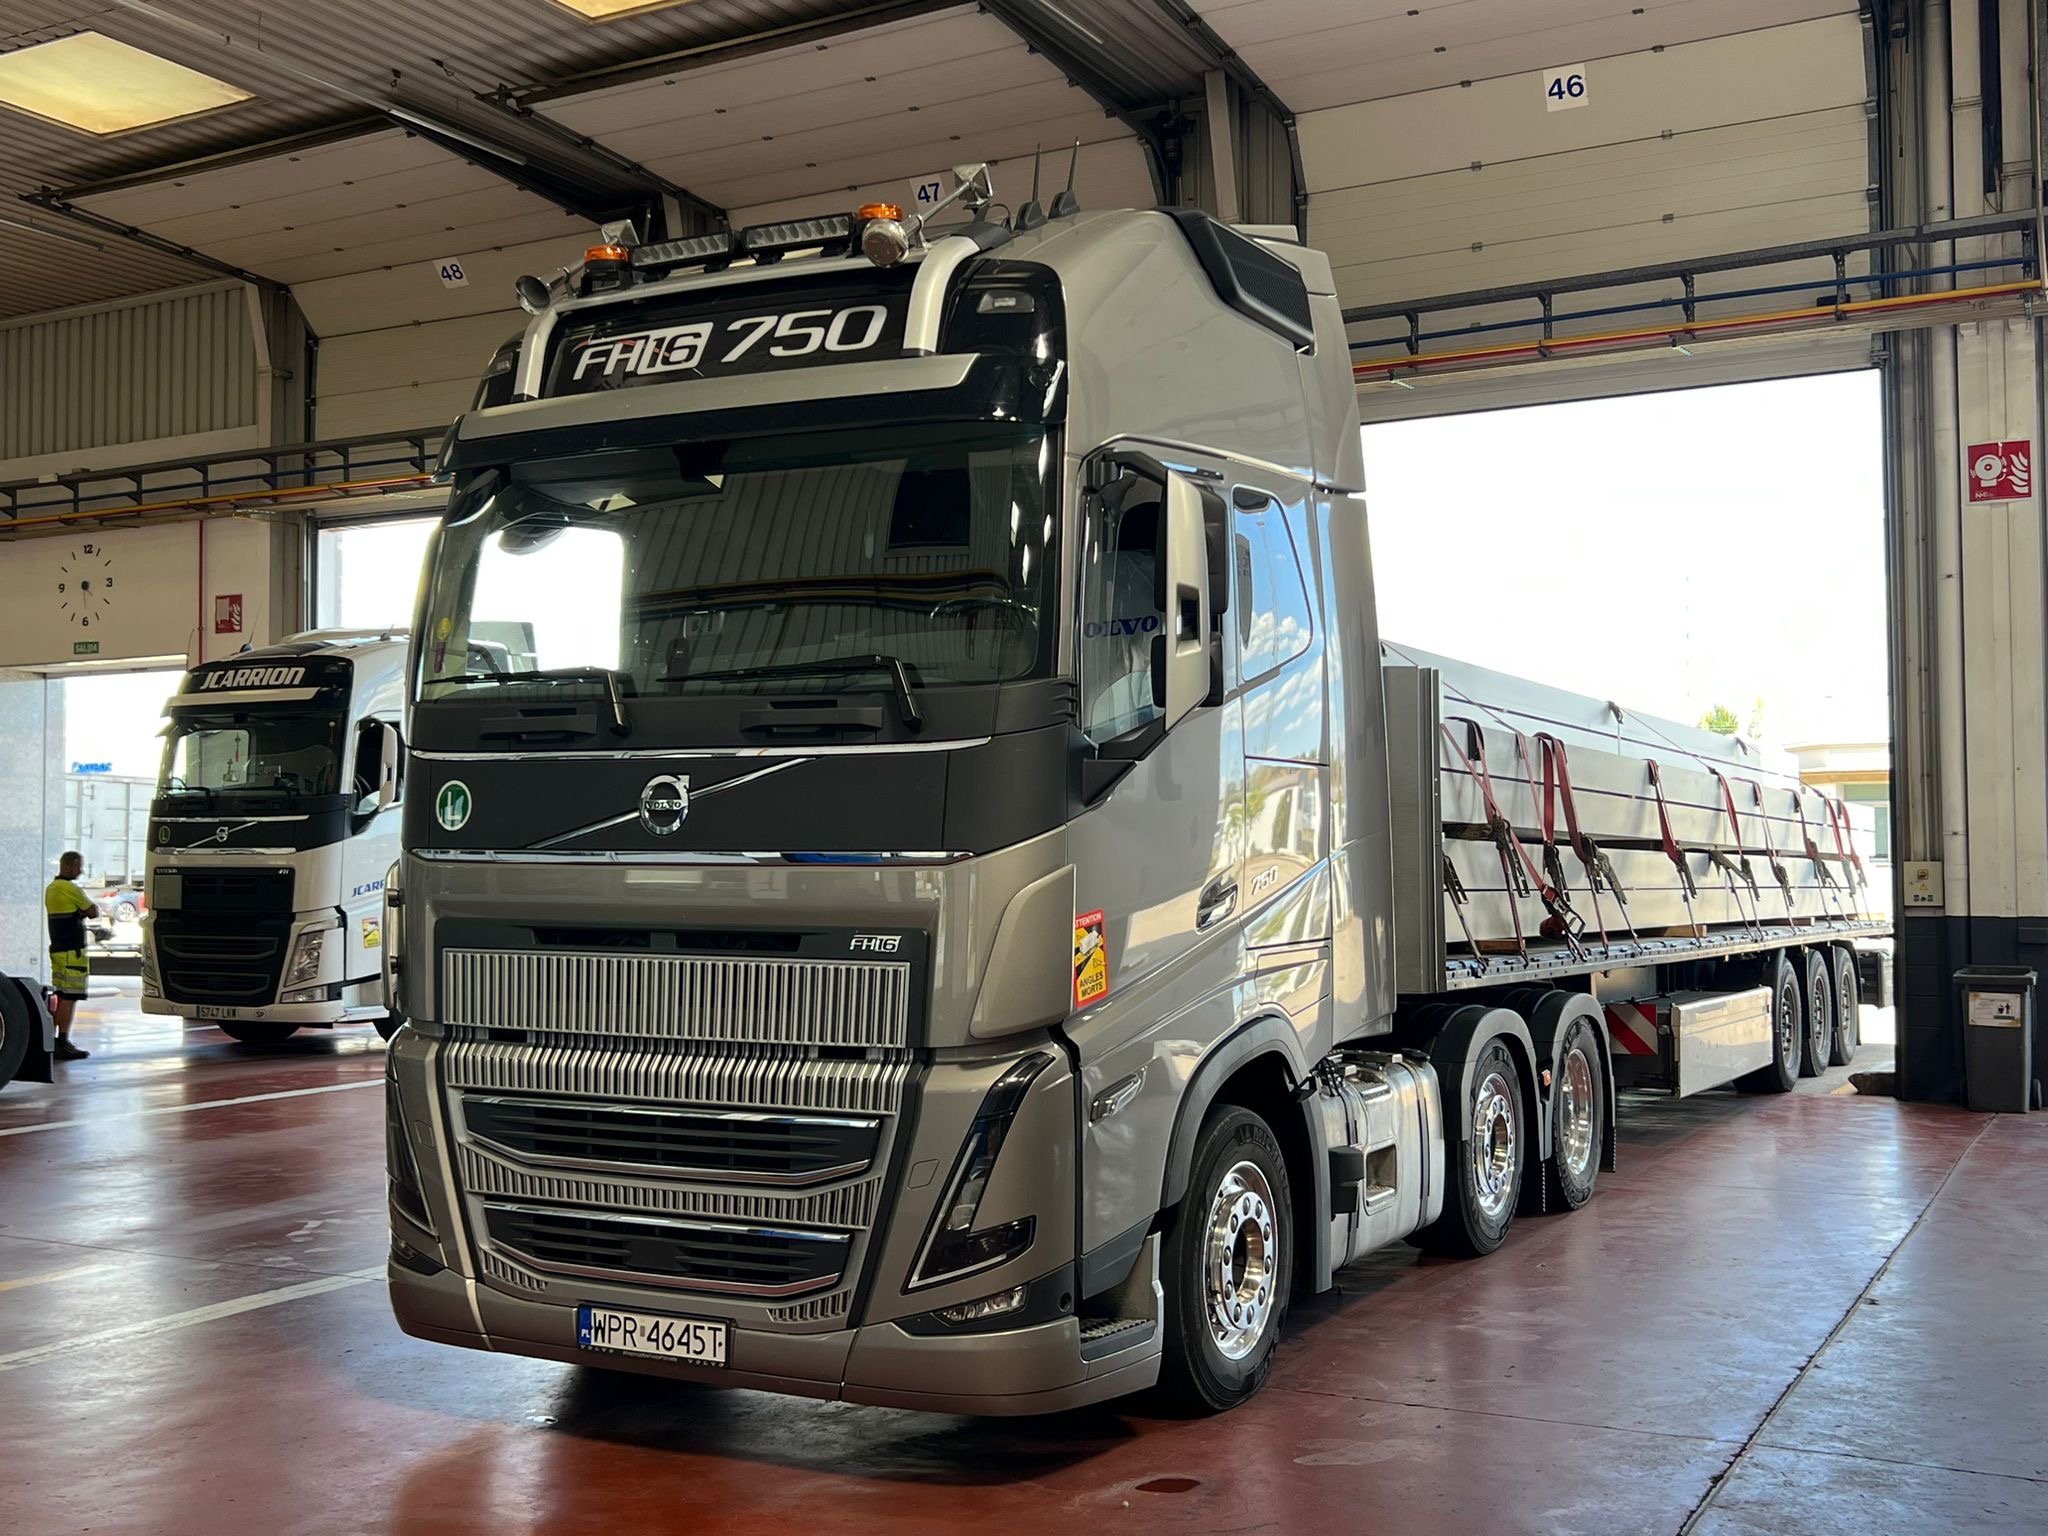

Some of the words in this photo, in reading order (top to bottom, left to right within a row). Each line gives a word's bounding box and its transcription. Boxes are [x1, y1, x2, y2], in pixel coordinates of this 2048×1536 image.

[1548, 74, 1585, 100] 46
[917, 182, 940, 203] 47
[441, 263, 464, 281] 48
[573, 322, 714, 381] FH16
[721, 305, 888, 363] 750
[83, 544, 94, 554] 12
[58, 583, 66, 594] 9
[106, 578, 113, 587] 3
[82, 617, 89, 627] 6
[200, 667, 306, 690] JCARRION
[644, 800, 682, 810] VOLVO
[1075, 911, 1102, 927] TTENTION
[850, 934, 902, 953] FH16
[1080, 970, 1104, 987] ANGLES
[1081, 981, 1103, 998] MORTS
[593, 1312, 638, 1348] WPR
[646, 1320, 722, 1358] 4645T
